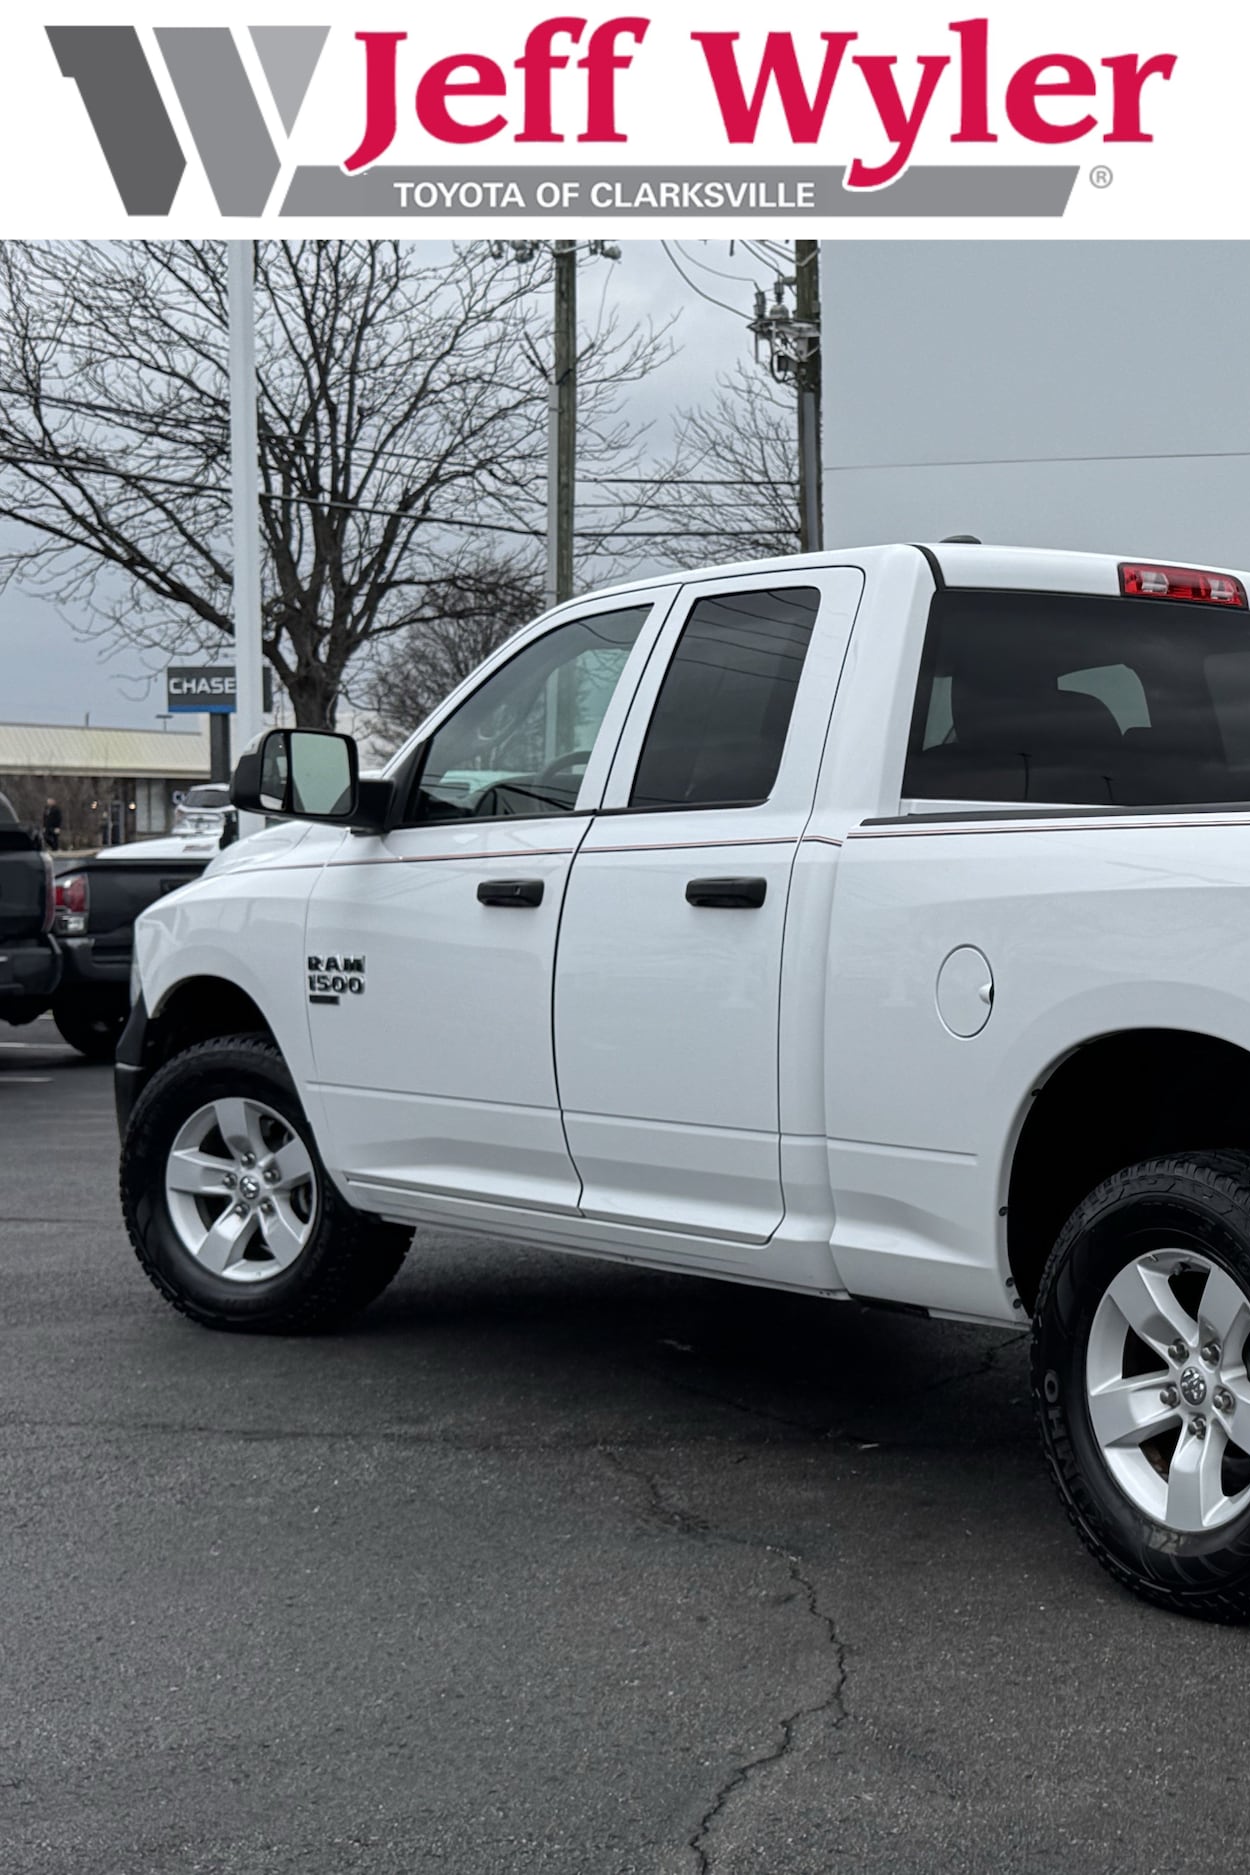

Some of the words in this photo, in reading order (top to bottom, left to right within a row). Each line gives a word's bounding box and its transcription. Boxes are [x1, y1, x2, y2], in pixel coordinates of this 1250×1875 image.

[169, 677, 237, 695] CHASE
[308, 955, 365, 974] RAM
[308, 974, 365, 995] 1500
